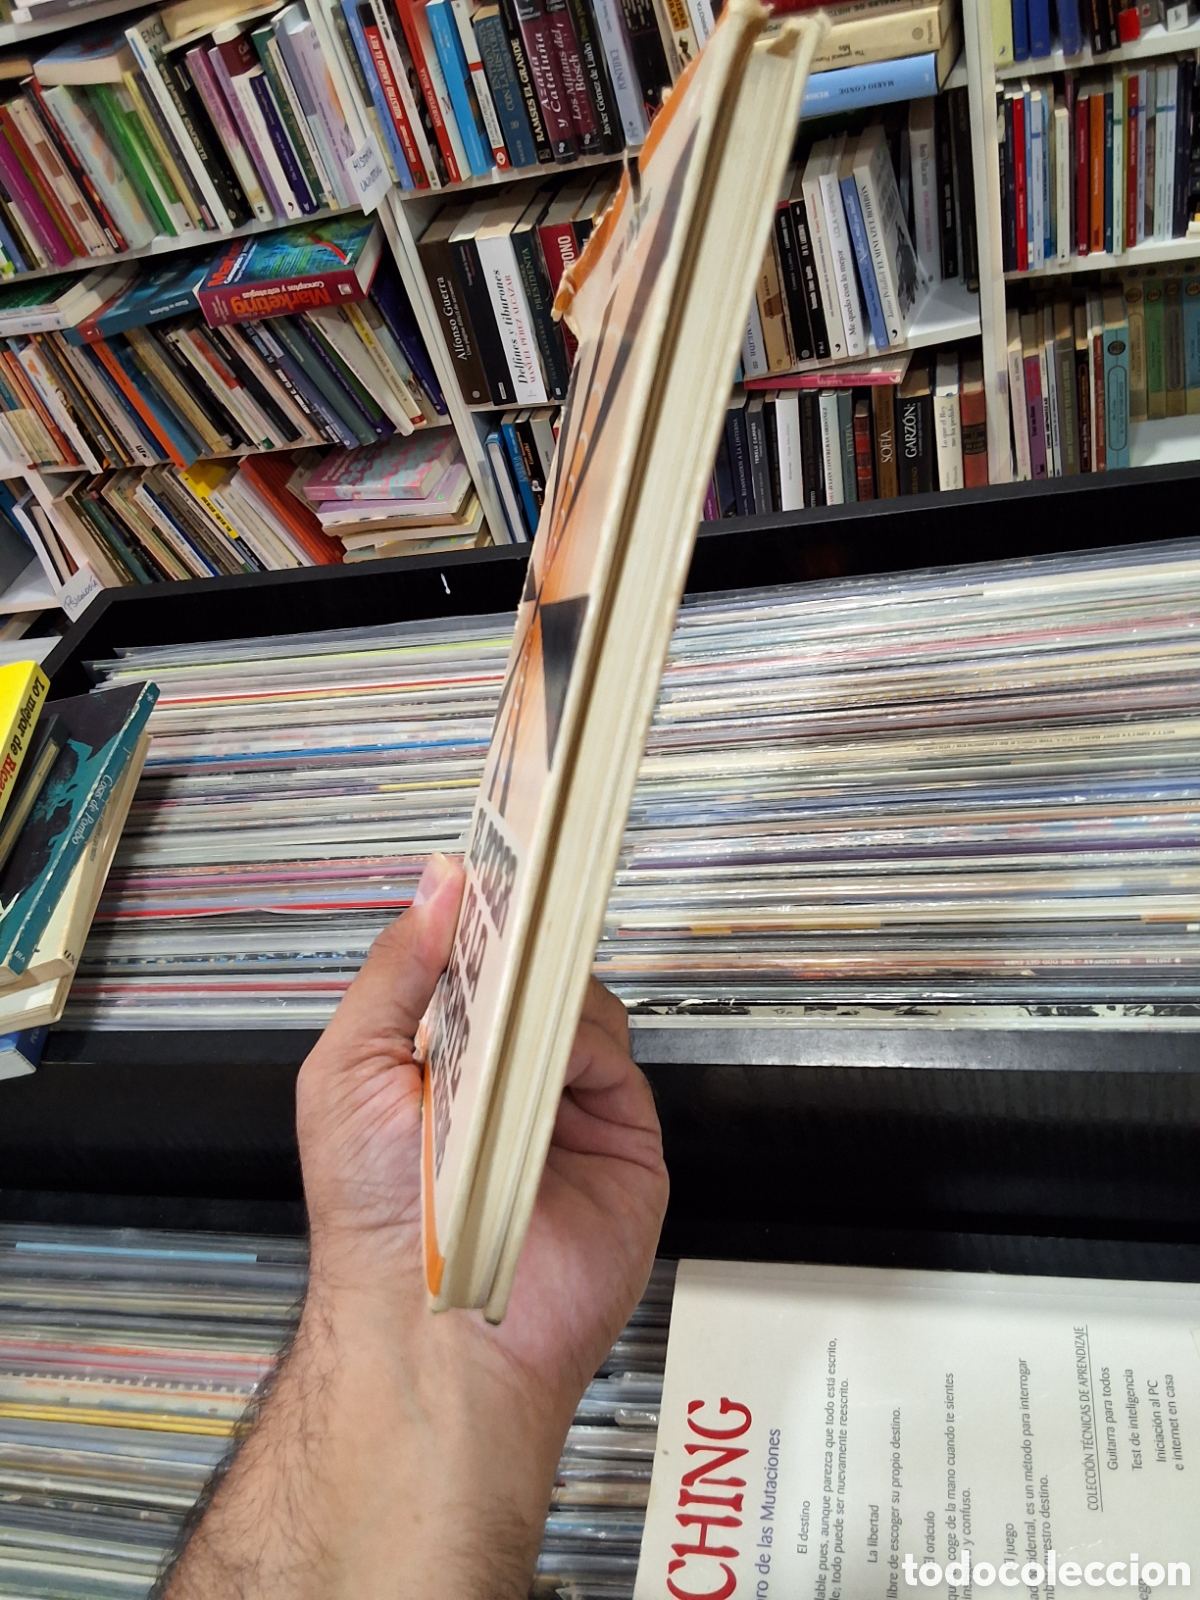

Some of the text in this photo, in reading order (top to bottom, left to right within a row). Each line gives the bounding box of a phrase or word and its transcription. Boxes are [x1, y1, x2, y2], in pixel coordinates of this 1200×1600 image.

[368, 33, 380, 50] REY
[377, 59, 392, 86] AMIGO
[509, 37, 546, 141] RAMSES EL GRANDE
[532, 56, 551, 110] Azaña
[535, 33, 568, 128] y Cataluña
[569, 54, 586, 91] Bosch
[588, 68, 598, 80] de
[589, 80, 607, 112] Gómez
[839, 80, 894, 95] MARIO CONDE
[386, 85, 403, 120] NUESTRO
[571, 100, 582, 120] Los
[598, 111, 612, 136] Javier
[826, 181, 840, 238] LOLA HERRERA
[230, 289, 332, 314] Marketing
[242, 288, 281, 299] estrategias
[292, 280, 325, 292] Conceptos
[493, 270, 514, 326] tiburones
[522, 247, 544, 310] PRESIDENTA
[836, 249, 856, 335] Me quedo con lo mejor
[432, 276, 468, 361] Alfonso Guerra
[512, 339, 528, 384] Delfines
[521, 350, 536, 384] MANUEL
[294, 394, 312, 414] ARTHUR
[939, 406, 949, 420] Rey
[524, 442, 534, 465] Gandhi
[880, 430, 892, 463] SOFÍA
[902, 402, 918, 458] GARZÓN:
[10, 676, 46, 756] Lo mejor de
[89, 797, 100, 813] de
[94, 774, 113, 800] Cosas
[71, 814, 95, 845] Pombo
[1019, 1358, 1036, 1516] es un método para interrogar
[1074, 1326, 1099, 1512] COLECCIÓN TÉCNICAS DE APRENDIZAJE
[1100, 1366, 1118, 1471] Guitarra para todos
[1124, 1368, 1142, 1472] Test de inteligencia
[1146, 1380, 1167, 1462] Iniciación al PC
[1164, 1374, 1184, 1472] e internet en casa
[818, 1337, 839, 1572] pues, aunque parezca que todo está escrito,
[944, 1373, 960, 1560] coge de la mano cuando te sientes
[666, 1397, 752, 1600] CHING
[754, 1428, 780, 1574] de las Mutaciones
[832, 1378, 850, 1583] todo puede ser nuevamente reescrito.
[886, 1406, 903, 1599] libre de escoger su propio destino.
[1038, 1474, 1051, 1518] destino.
[797, 1500, 811, 1554] El destino
[867, 1504, 880, 1564] La libertad
[924, 1510, 936, 1554] oráculo
[960, 1487, 972, 1536] confuso.
[962, 1537, 975, 1546] y
[1004, 1523, 1018, 1555] juego
